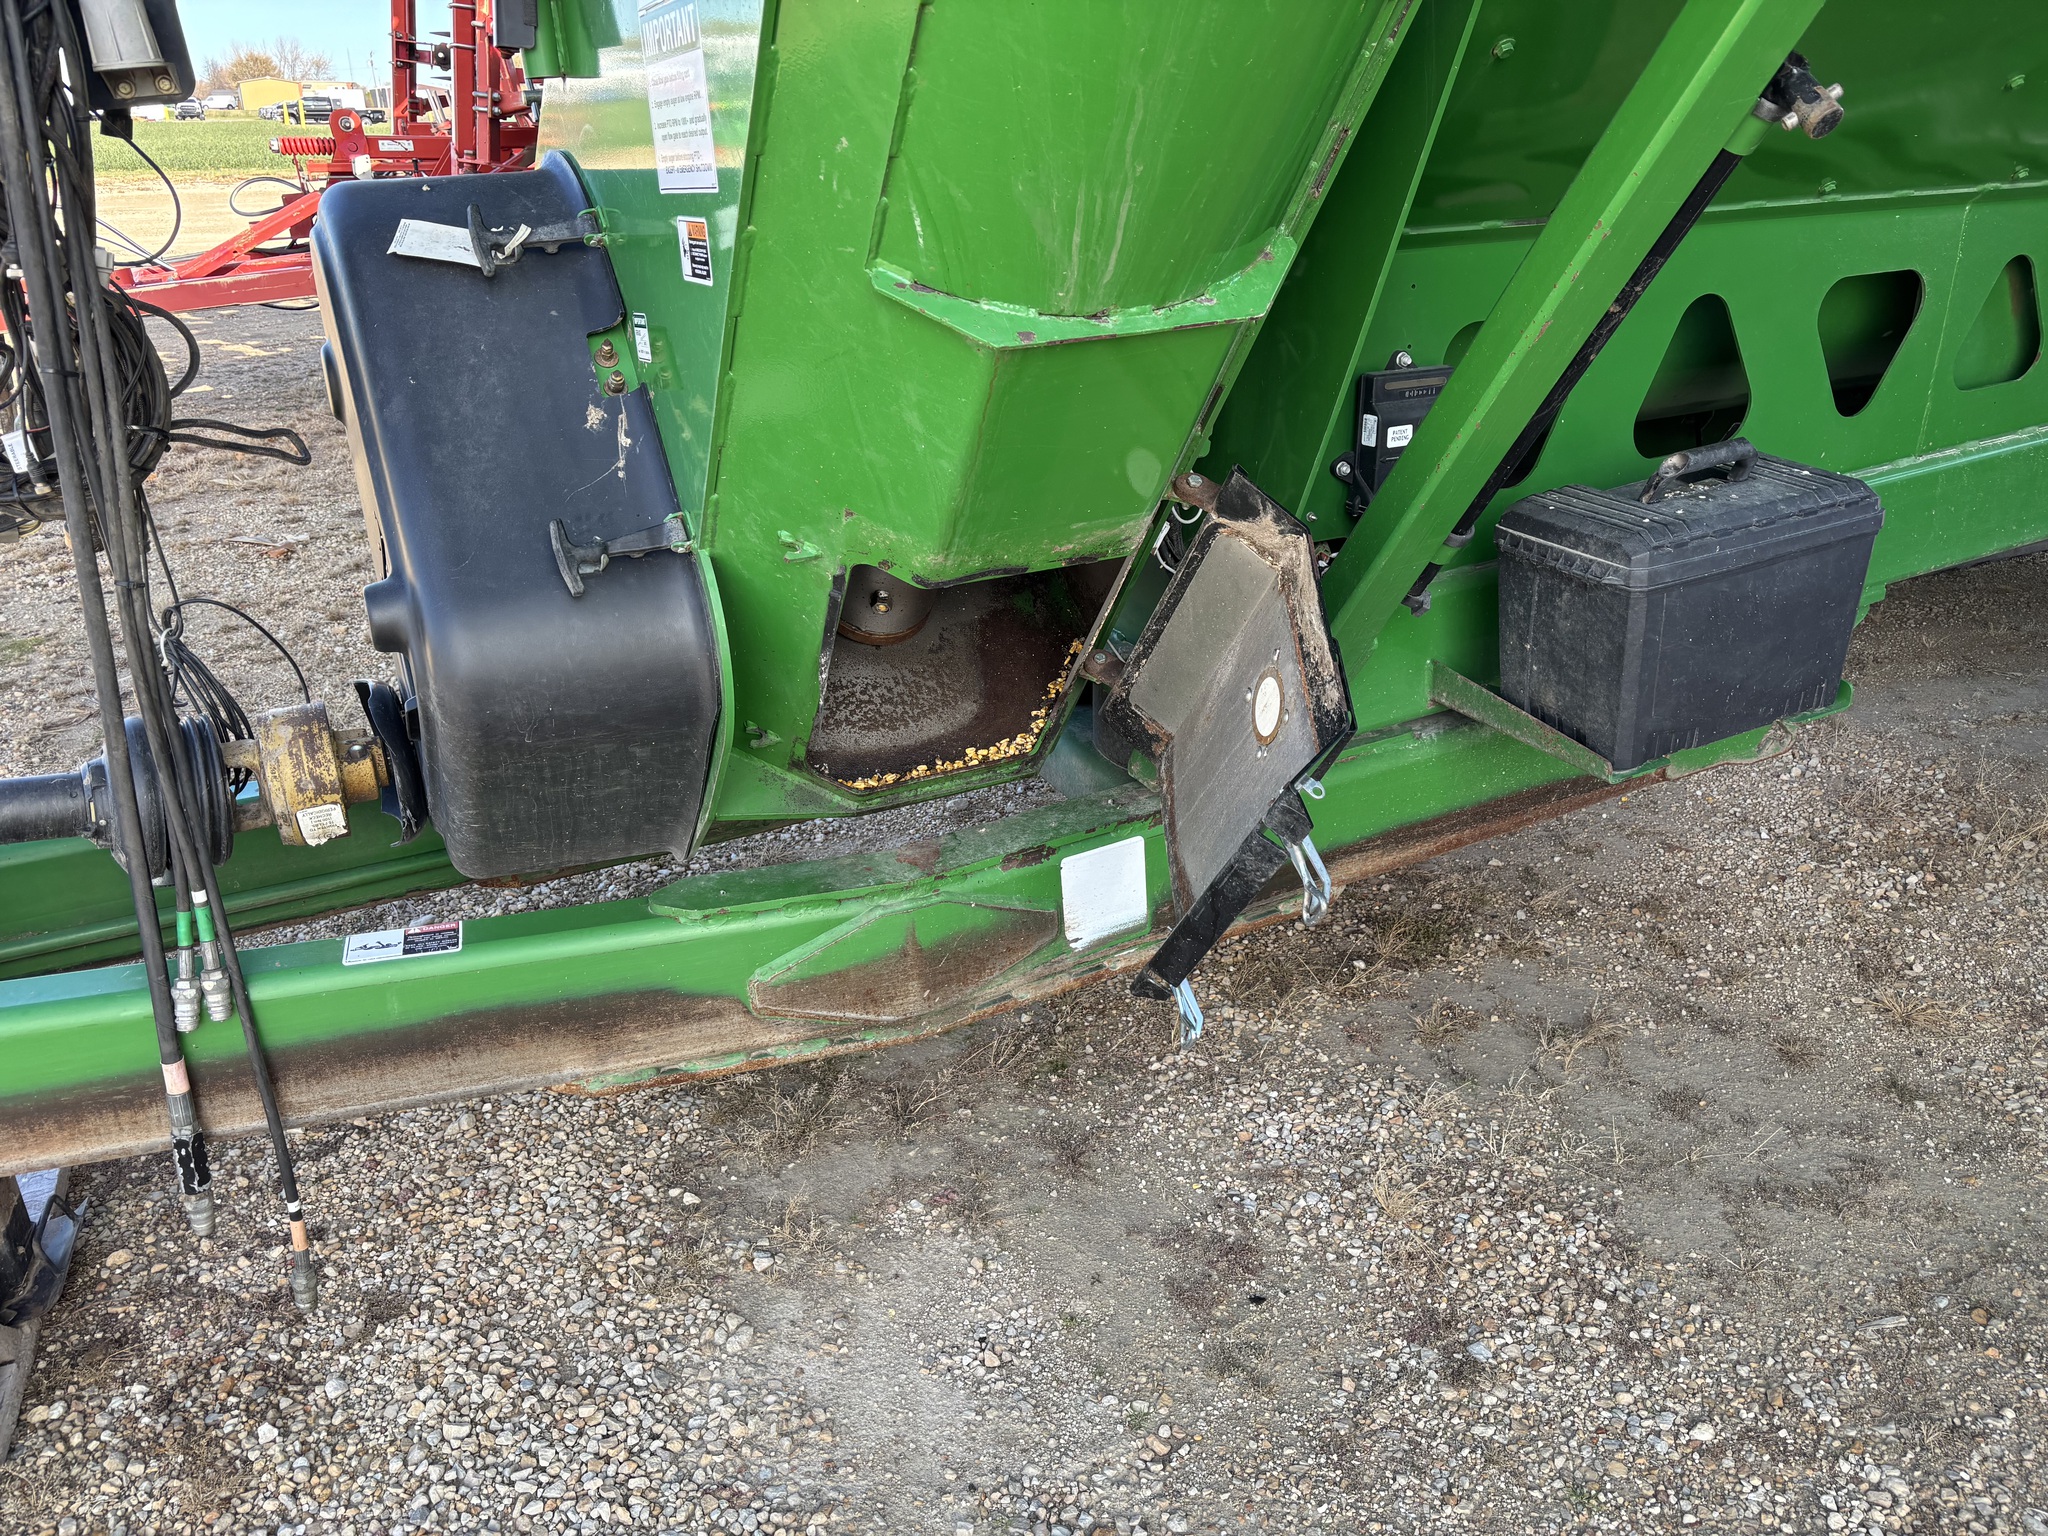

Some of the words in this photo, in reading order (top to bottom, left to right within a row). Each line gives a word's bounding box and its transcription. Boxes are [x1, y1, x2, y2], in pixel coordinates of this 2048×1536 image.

[642, 3, 696, 57] IMPORTANT
[1391, 434, 1409, 442] PENDING
[8, 443, 23, 470] STEERABLE
[302, 807, 336, 817] PERIODICALLY
[309, 812, 332, 820] RECHECK
[422, 923, 456, 931] DANGER
